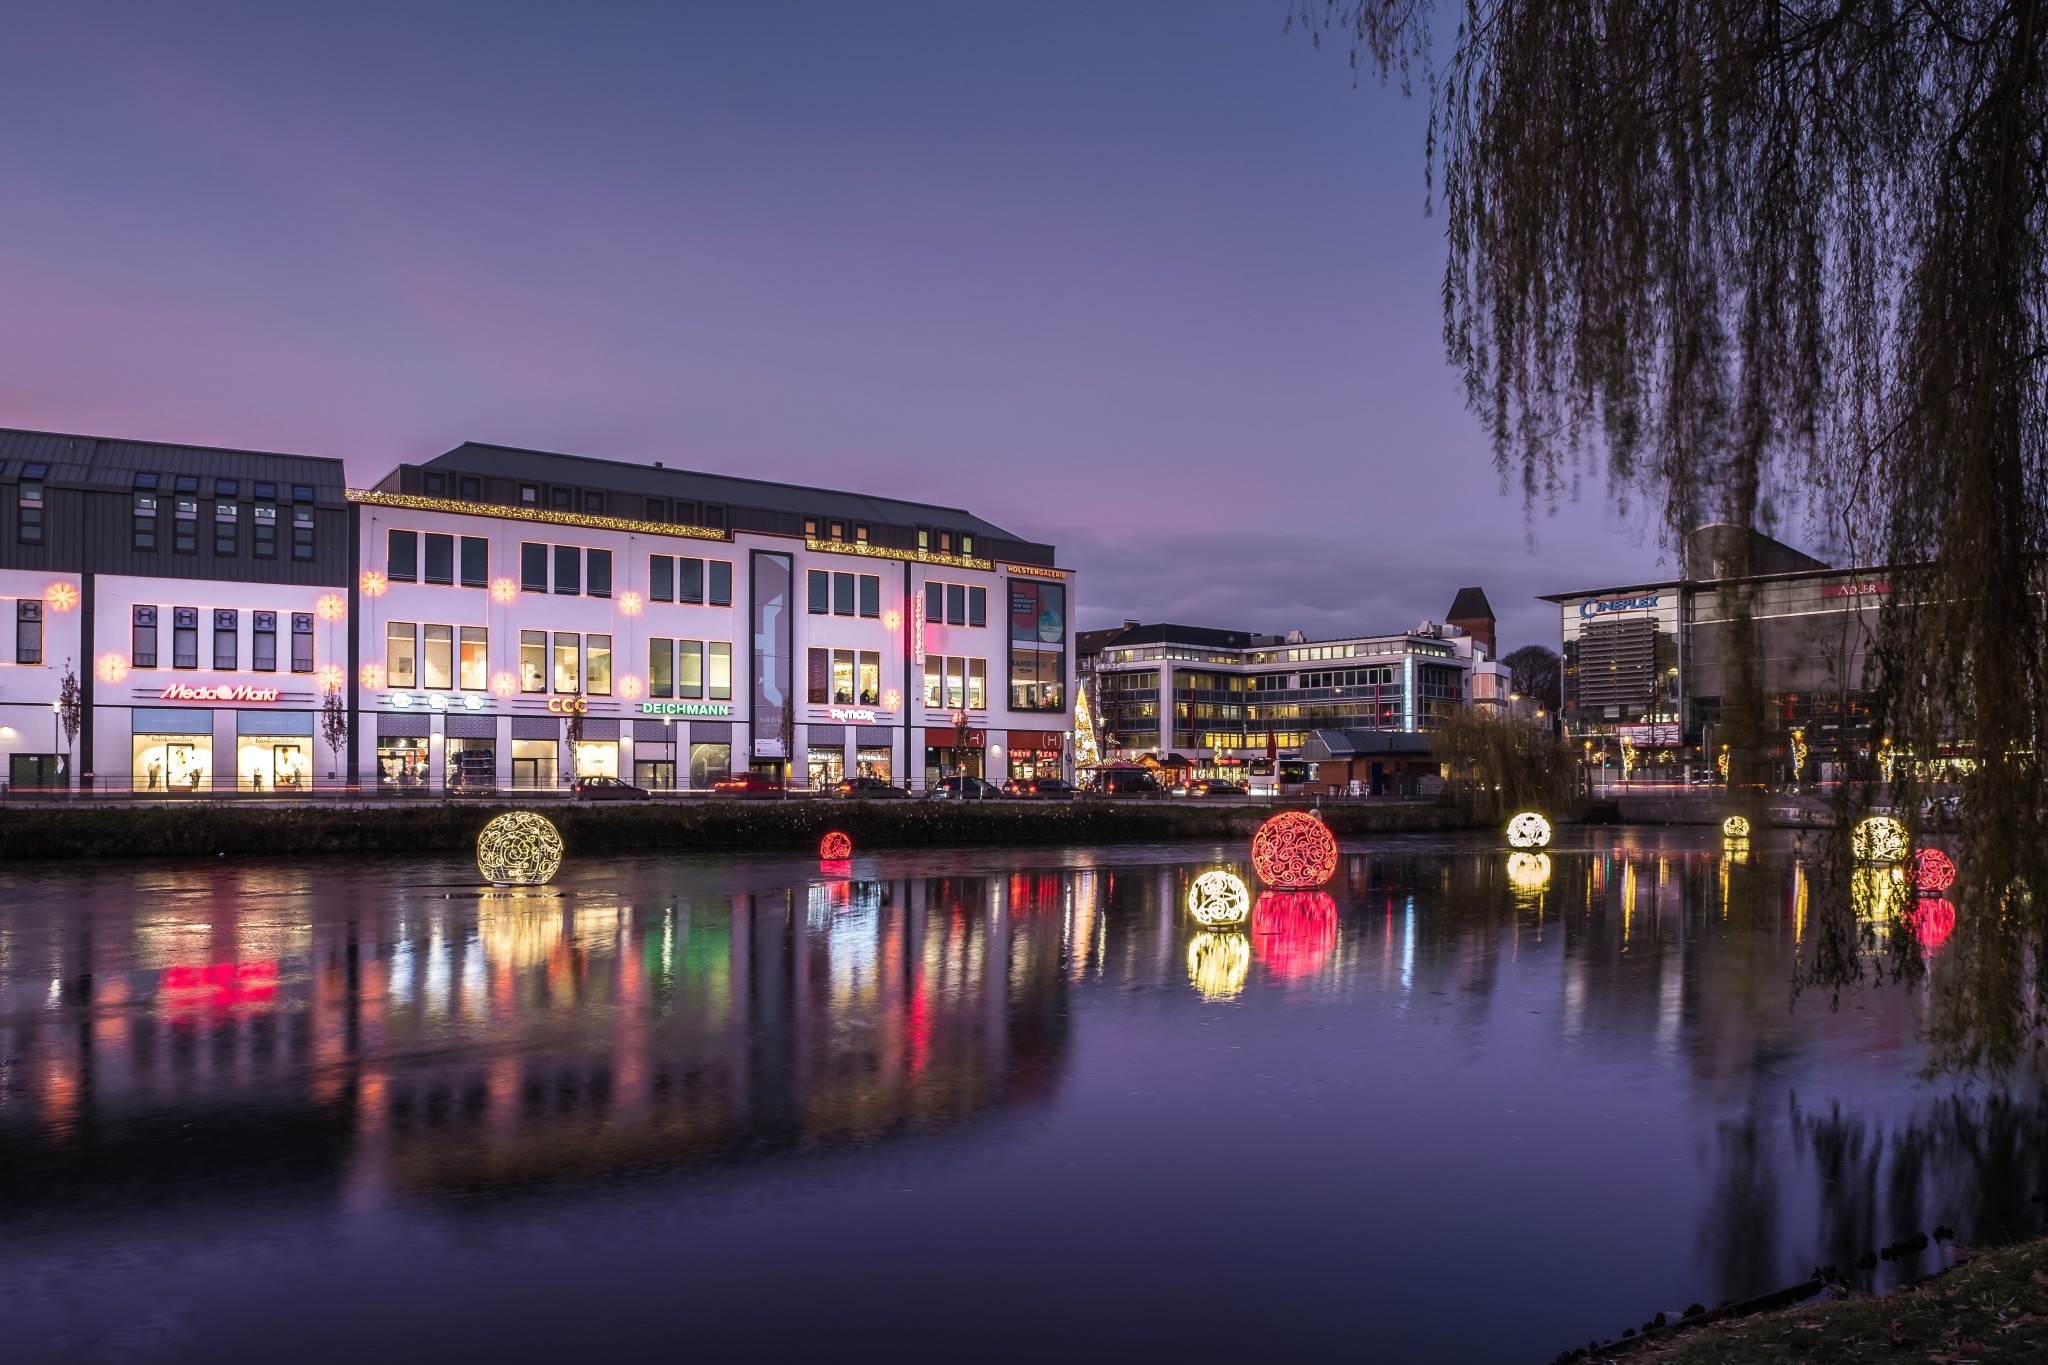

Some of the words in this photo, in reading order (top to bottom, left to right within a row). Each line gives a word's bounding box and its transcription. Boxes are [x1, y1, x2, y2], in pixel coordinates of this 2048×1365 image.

[1008, 566, 1066, 579] HOLSTENGALERIE
[1838, 585, 1876, 596] ADLER
[1580, 596, 1659, 618] CINEPLEX
[548, 698, 588, 713] CCC
[642, 702, 729, 716] DEICHMANN
[1010, 749, 1031, 758] TOKYO
